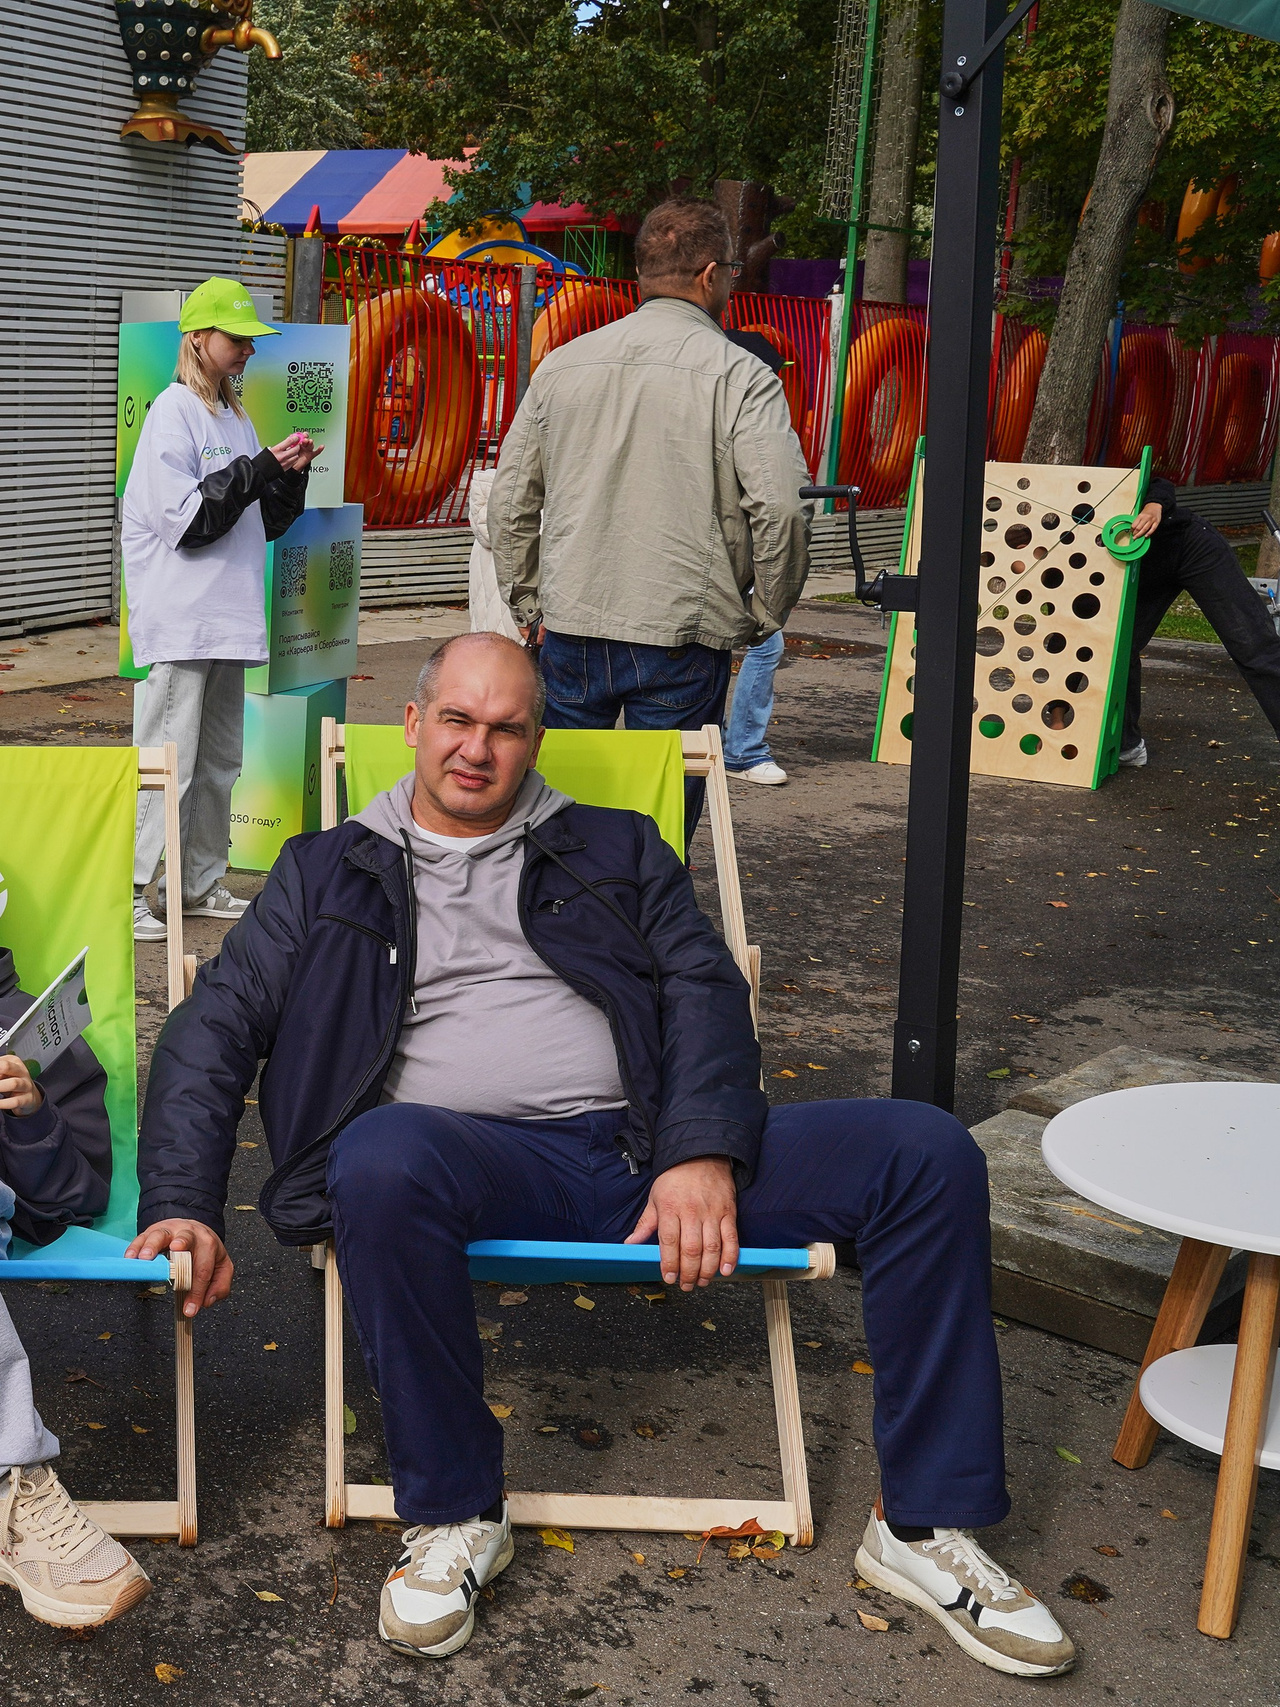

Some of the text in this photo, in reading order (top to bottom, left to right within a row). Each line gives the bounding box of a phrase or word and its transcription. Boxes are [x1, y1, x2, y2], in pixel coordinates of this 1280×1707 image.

[292, 425, 325, 434] Телеграм
[281, 608, 304, 617] ВКонтакте
[278, 629, 321, 644] Подписывайся
[278, 649, 286, 658] на
[229, 813, 282, 829] 050 году?
[36, 1021, 52, 1050] дня!
